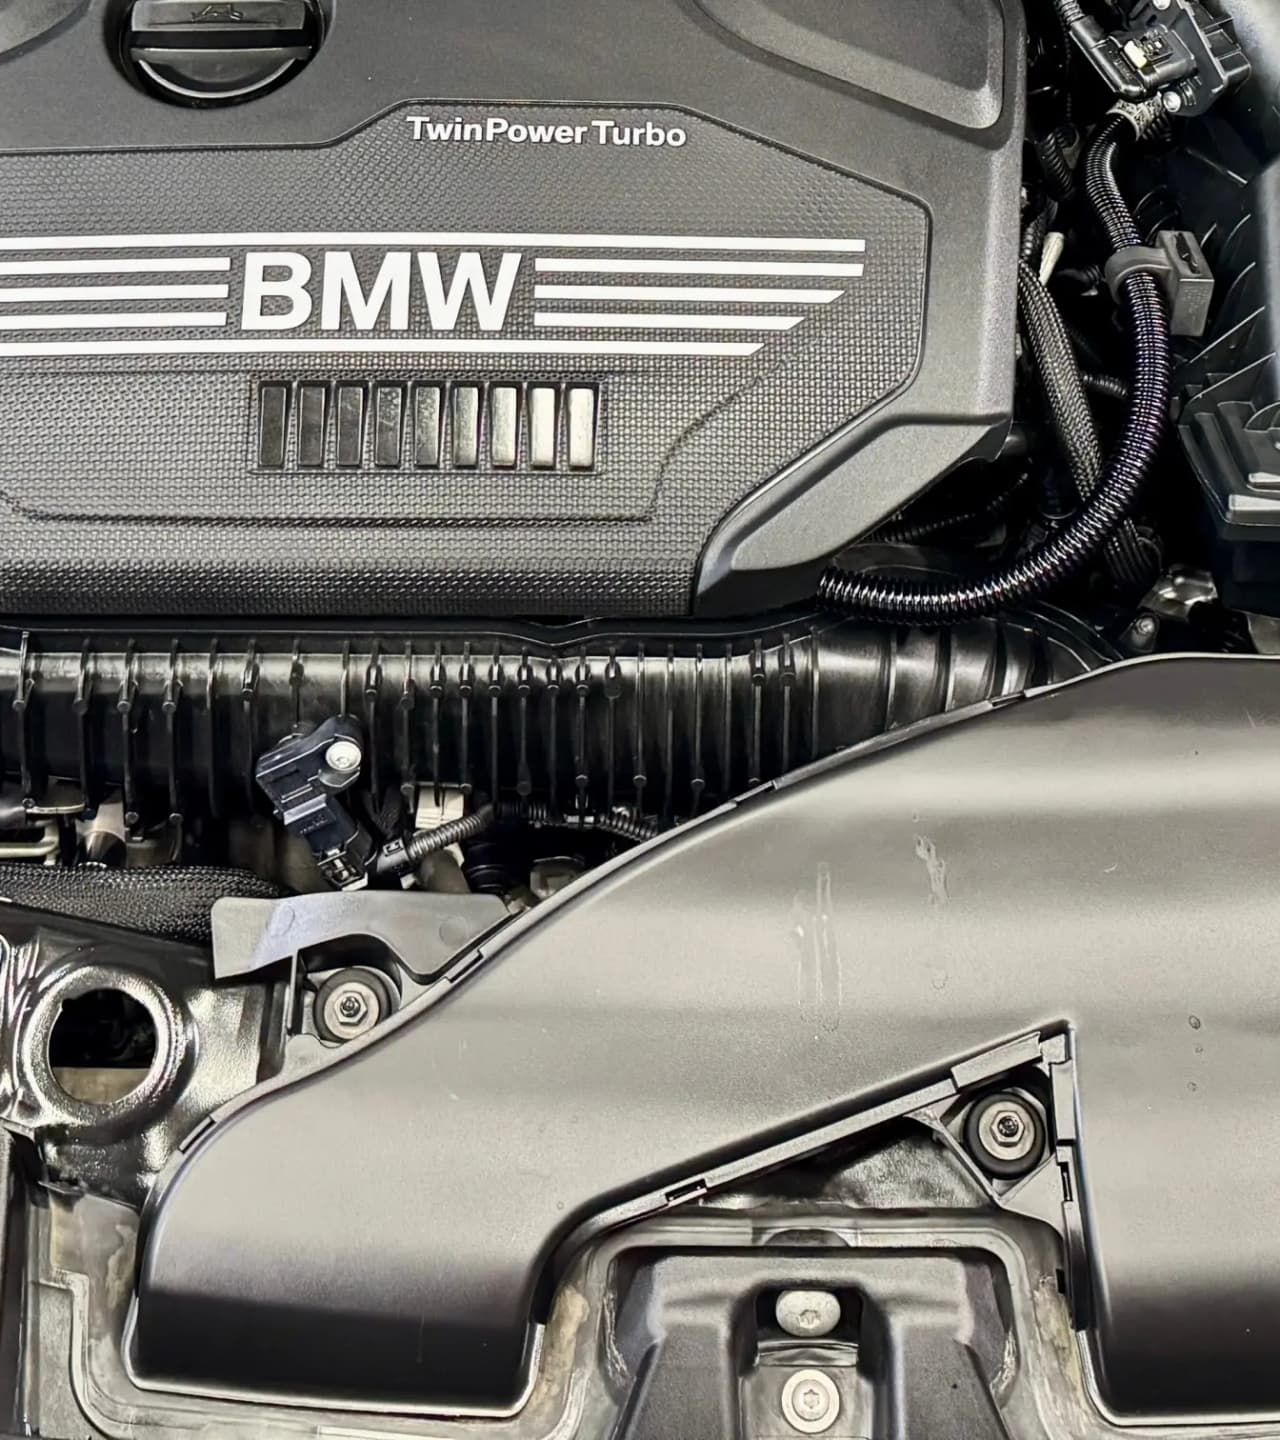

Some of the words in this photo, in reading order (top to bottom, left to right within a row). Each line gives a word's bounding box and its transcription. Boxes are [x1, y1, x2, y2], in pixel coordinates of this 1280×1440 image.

[406, 116, 587, 144] TwinPower
[591, 120, 686, 147] Turbo
[241, 251, 522, 331] BMW
